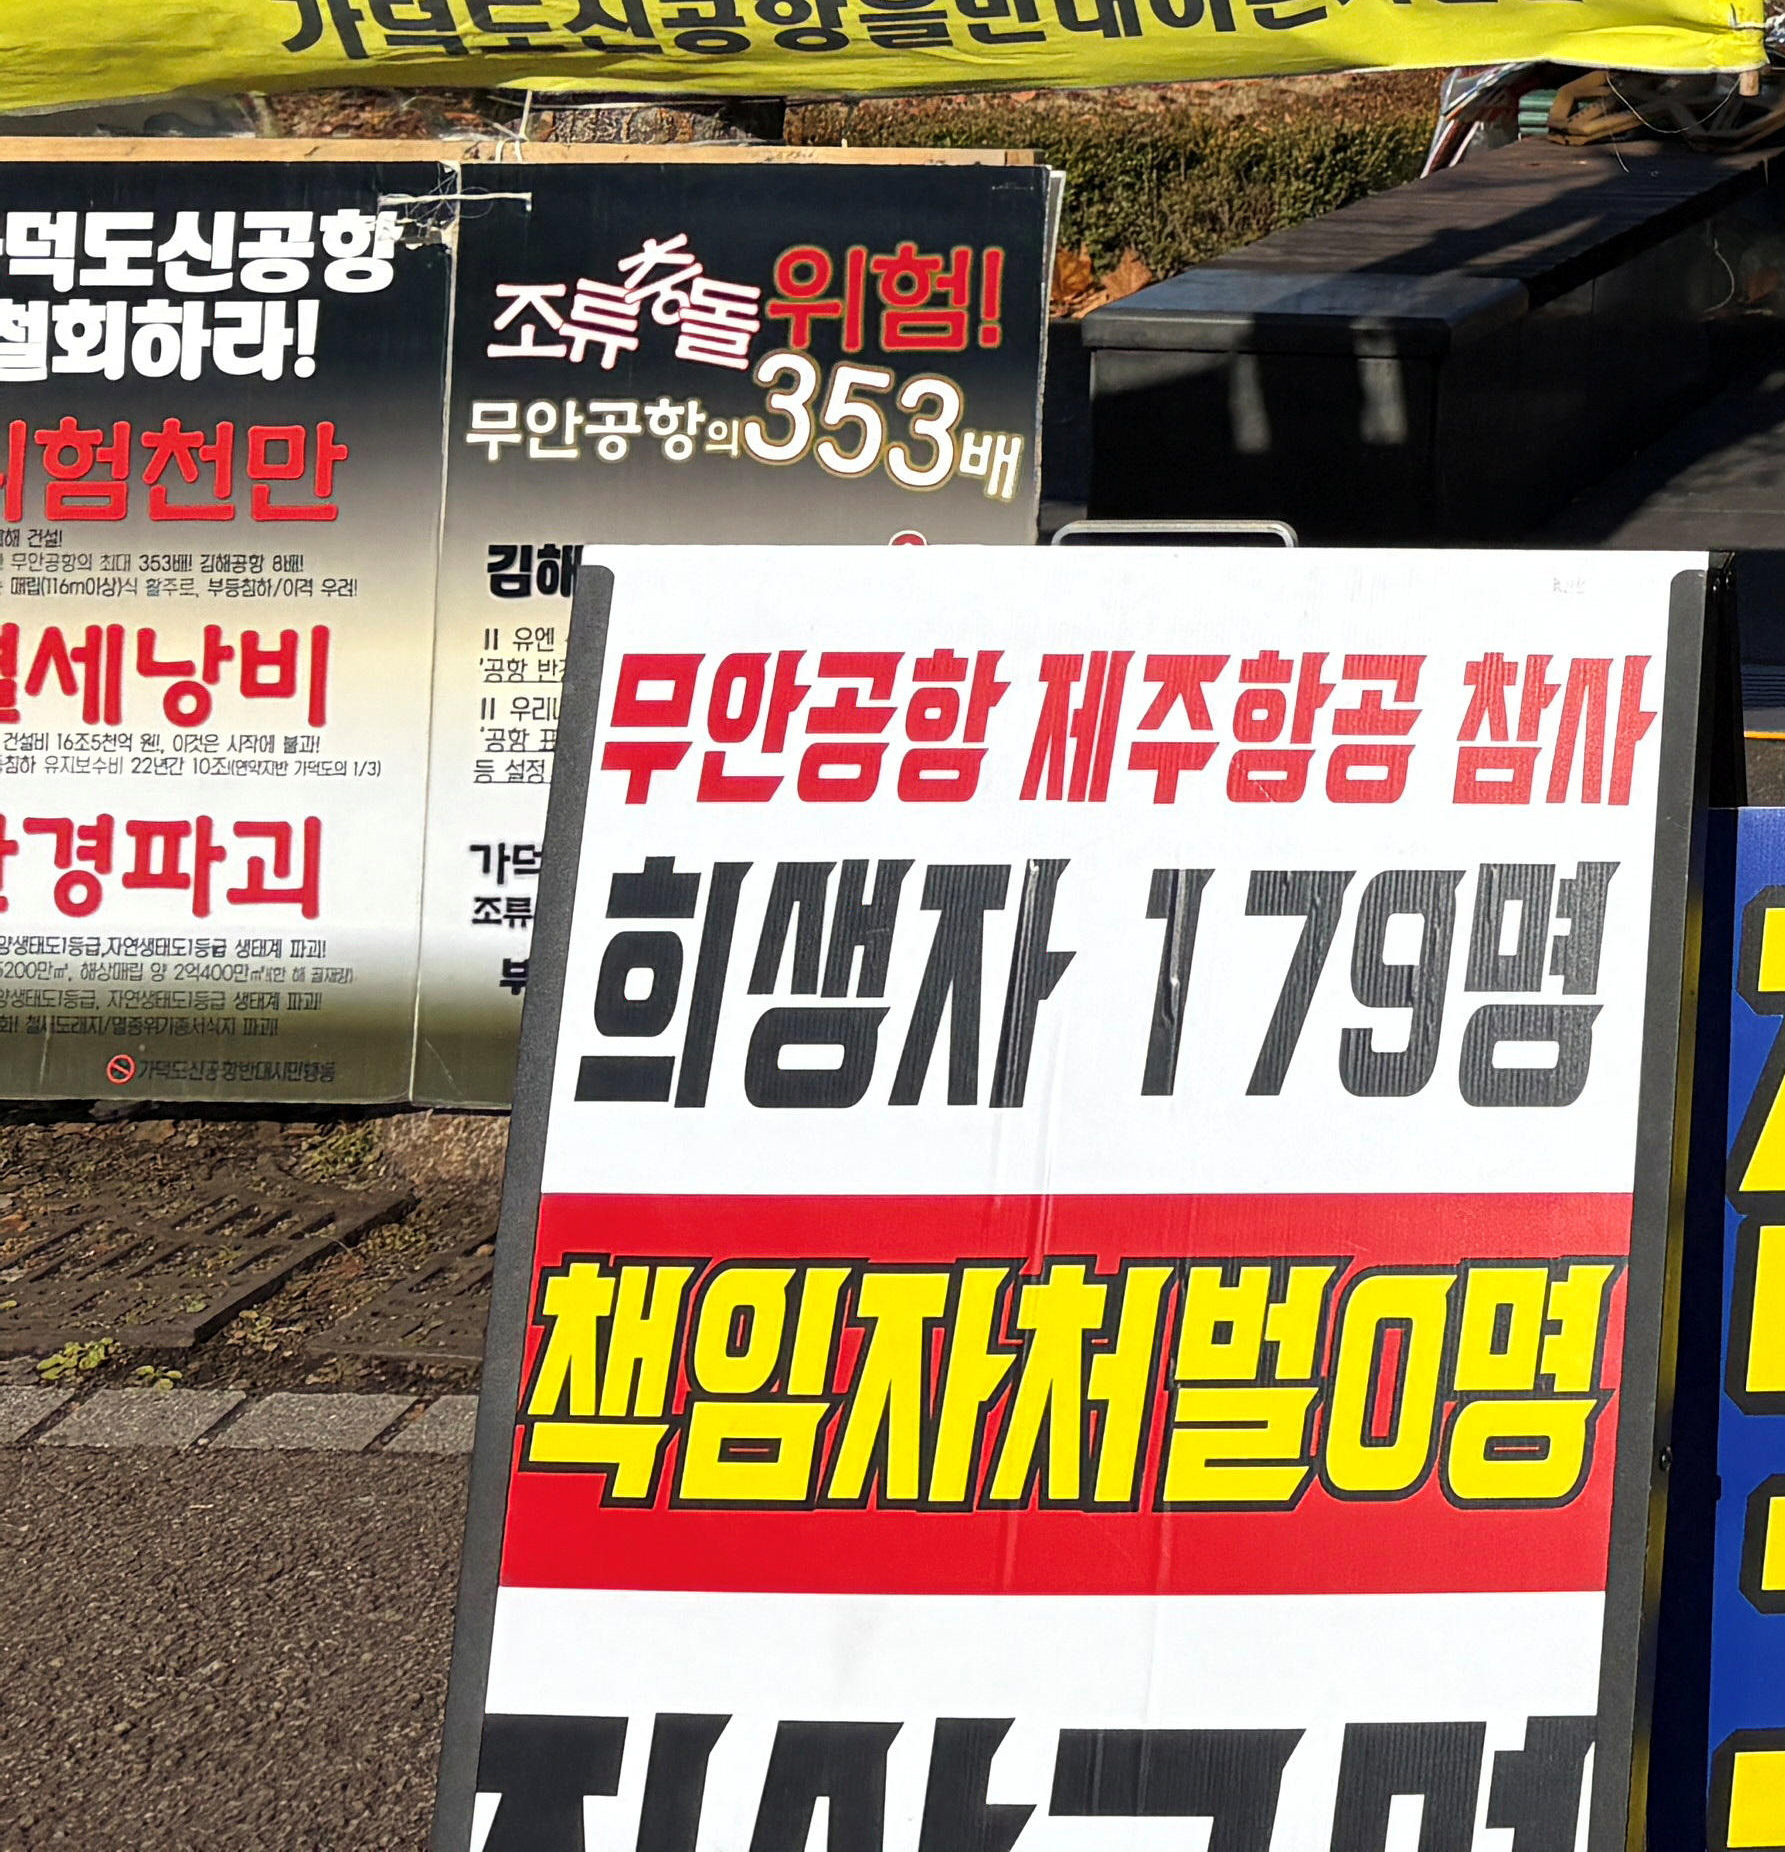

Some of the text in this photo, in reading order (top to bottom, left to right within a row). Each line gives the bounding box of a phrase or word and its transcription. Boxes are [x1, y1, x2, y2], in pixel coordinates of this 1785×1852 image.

[0, 208, 398, 293] 덕도신공항
[766, 241, 1005, 352] 위험!
[466, 350, 1024, 500] 무안공항의 353배
[28, 528, 63, 548] 건설!
[11, 552, 304, 574] 무안공항의 최대 353배! 김해공항 8배!
[512, 627, 554, 652] 유엔
[601, 649, 1656, 806] 무안공항 제주항공 참사
[3, 732, 49, 752] 건설비
[57, 733, 133, 753] 16조5천억
[172, 733, 220, 754] 이것은
[226, 734, 276, 754] 시작에
[44, 755, 123, 775] 유지보수비
[131, 756, 185, 776] 22년간
[294, 760, 347, 777] 가덕도의
[353, 759, 382, 777] 1/3)
[474, 759, 546, 783] 등 설정
[471, 896, 533, 928] 조류
[235, 938, 283, 959] 생태계
[289, 939, 327, 959] 파괴!
[80, 961, 143, 982] 해상매립
[150, 962, 168, 982] 양
[575, 856, 1622, 1108] 희생자 179명
[233, 991, 280, 1011] 생태계
[287, 992, 323, 1011] 파괴!
